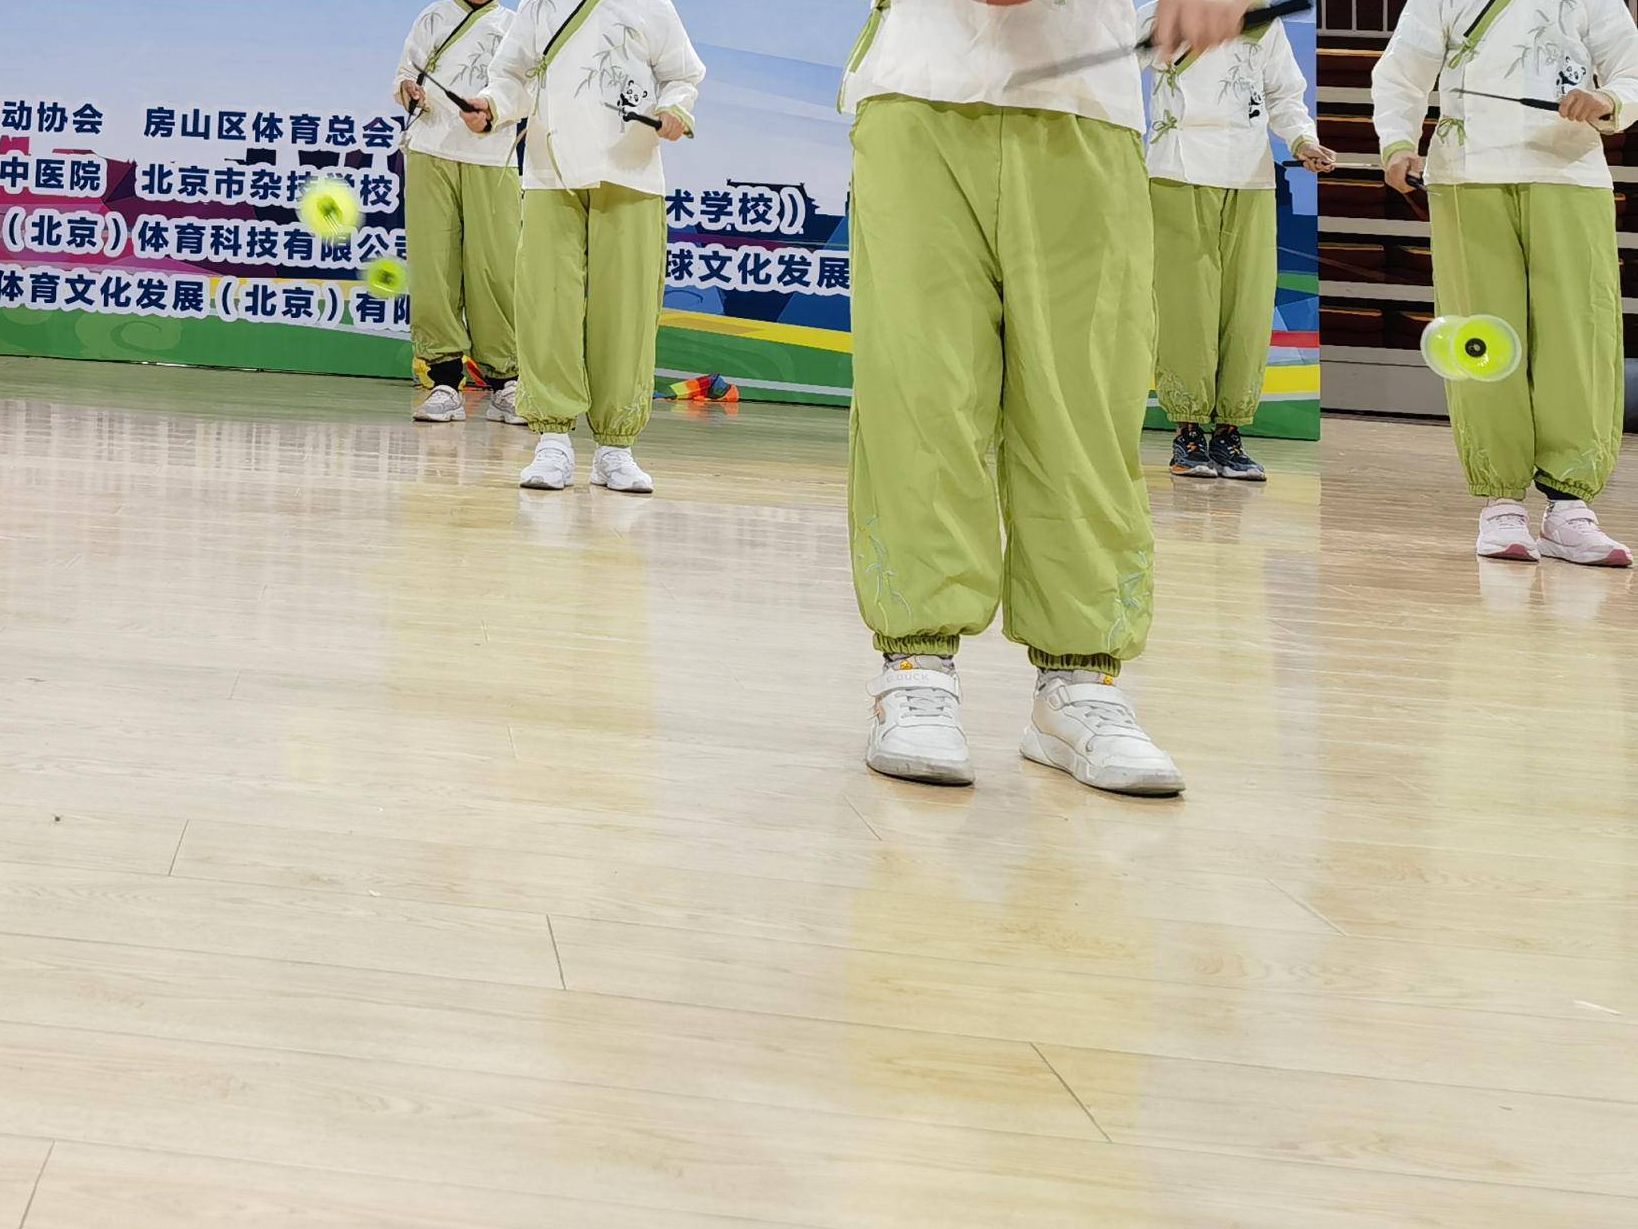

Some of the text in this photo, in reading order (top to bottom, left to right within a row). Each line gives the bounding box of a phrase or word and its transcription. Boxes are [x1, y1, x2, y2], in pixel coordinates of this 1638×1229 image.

[144, 107, 394, 149] 房山区体育总会
